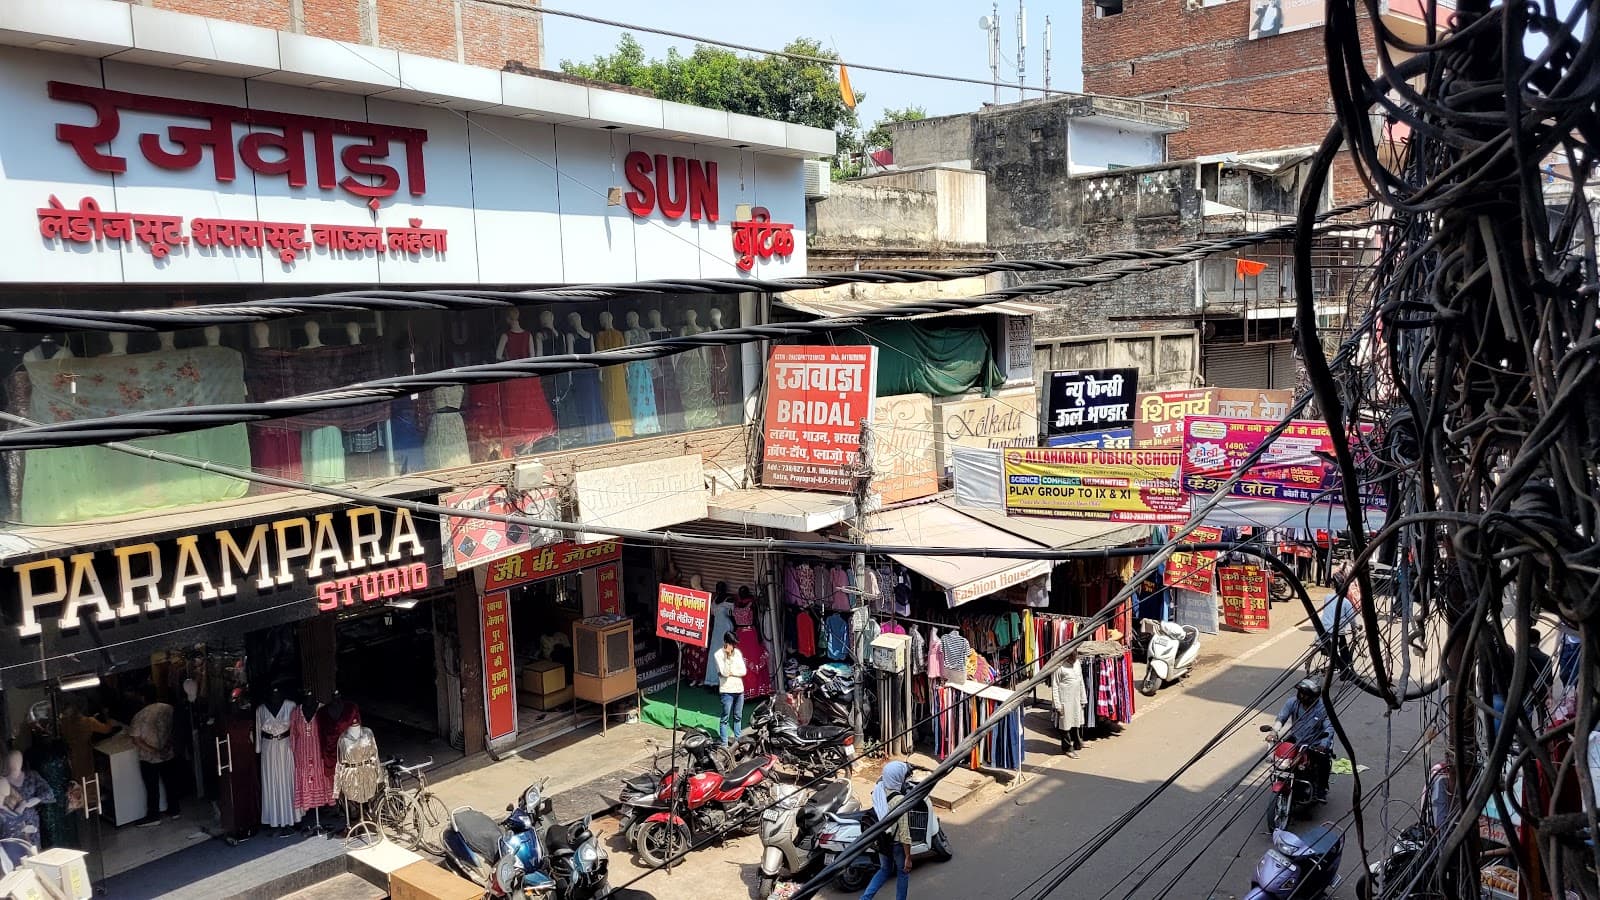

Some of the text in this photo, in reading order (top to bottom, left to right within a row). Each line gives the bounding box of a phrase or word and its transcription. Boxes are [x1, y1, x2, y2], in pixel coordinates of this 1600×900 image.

[47, 81, 428, 210] रजवाड़ा
[625, 151, 719, 222] SUN
[37, 195, 132, 242] लेडीज
[191, 217, 264, 248] शरारा
[731, 206, 795, 271] बुटिक
[775, 363, 865, 400] रजवाड़ा
[1066, 374, 1124, 406] न्यू फैन्सी
[778, 400, 854, 427] BRIDAL
[946, 404, 1021, 440] Kolkata
[1056, 403, 1129, 428] ऊल भण्डार
[1026, 451, 1088, 465] ALLAHABAD
[1091, 451, 1133, 465] PUBLIC
[1010, 475, 1128, 487] SCIENCE COMMERCE HUMANITIES
[1010, 486, 1131, 500] PLAY GROUP TO IX & XI
[1133, 477, 1179, 488] Admissio
[1149, 487, 1179, 497] OPEN
[14, 505, 425, 637] PARAMPARA
[316, 562, 428, 612] STUDIO
[954, 568, 1031, 600] Fashion House
